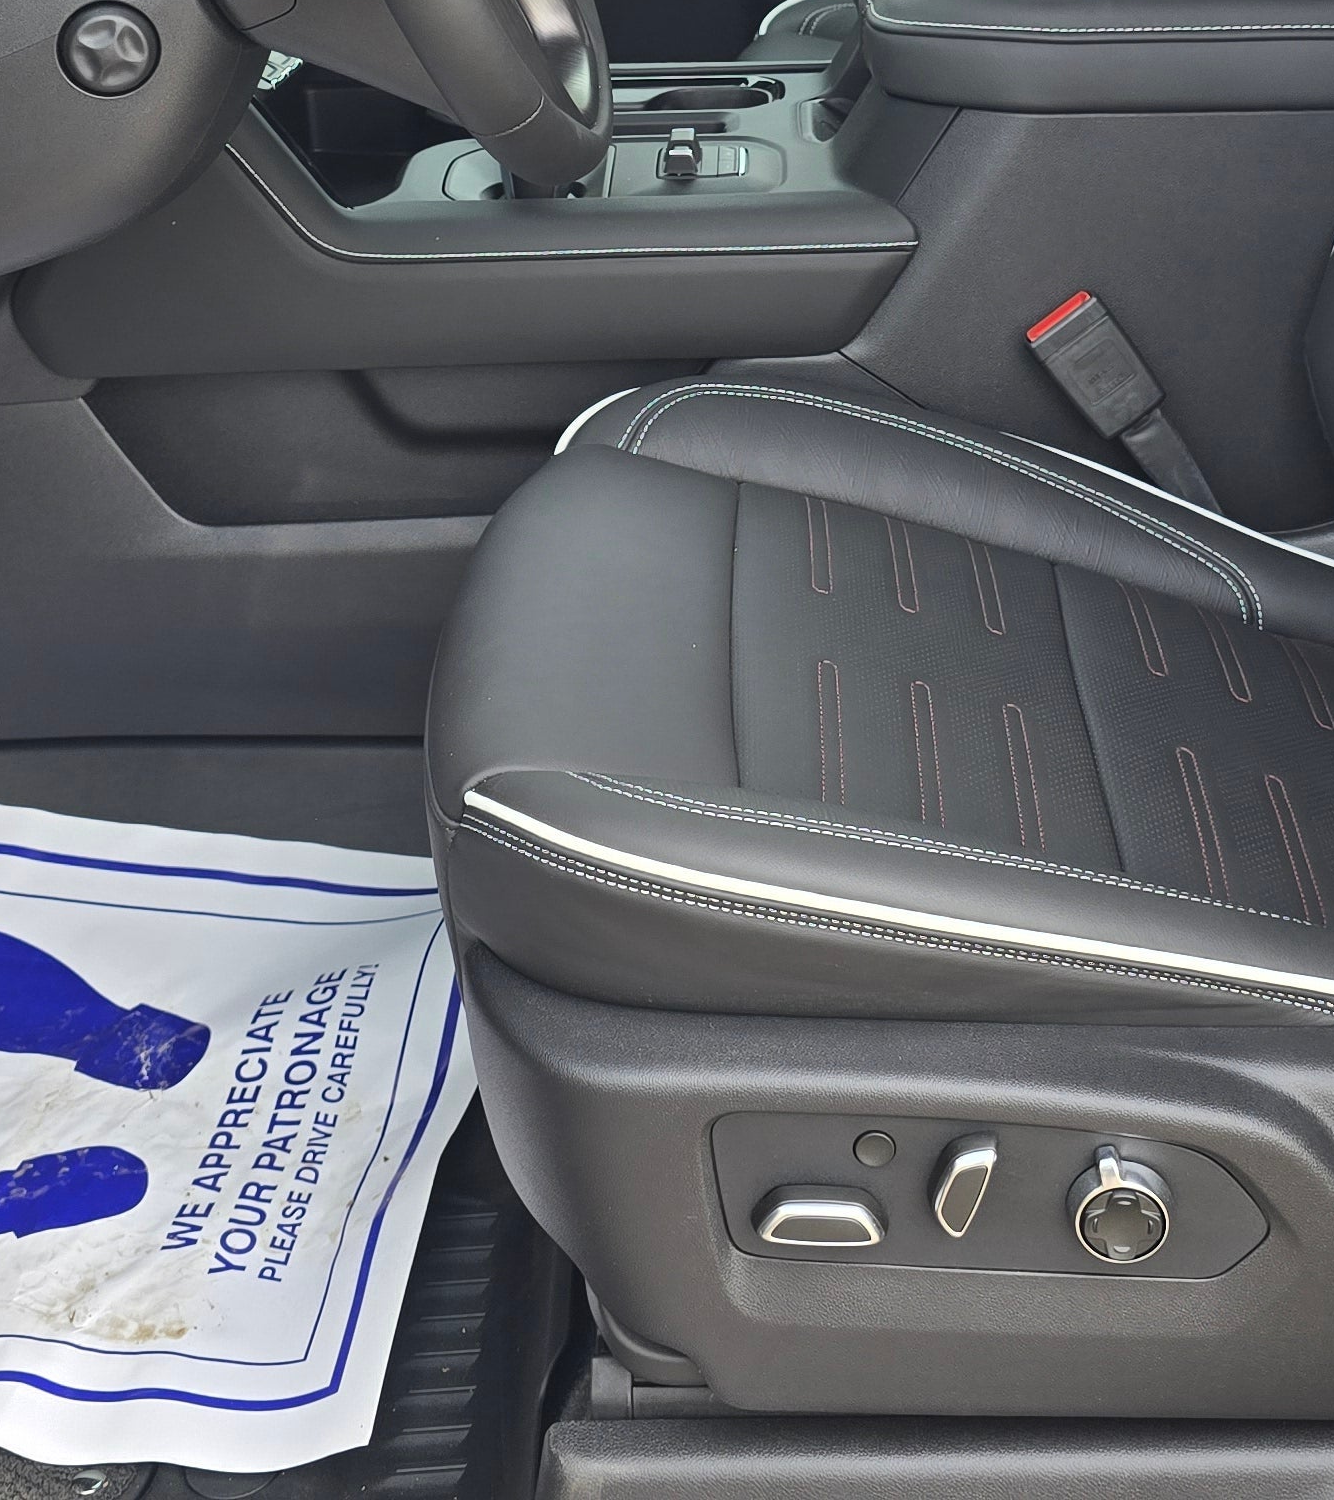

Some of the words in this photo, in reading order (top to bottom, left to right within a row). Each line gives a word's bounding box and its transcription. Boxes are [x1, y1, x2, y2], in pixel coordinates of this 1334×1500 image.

[161, 1191, 214, 1251] WE
[192, 989, 294, 1192] APPRECIATE
[207, 1181, 278, 1275] YOUR
[252, 967, 349, 1172] PATRONAGE
[258, 1190, 312, 1282] PLEASE
[295, 1111, 338, 1185] DRIVE
[321, 963, 380, 1103] CAREFULLY!
